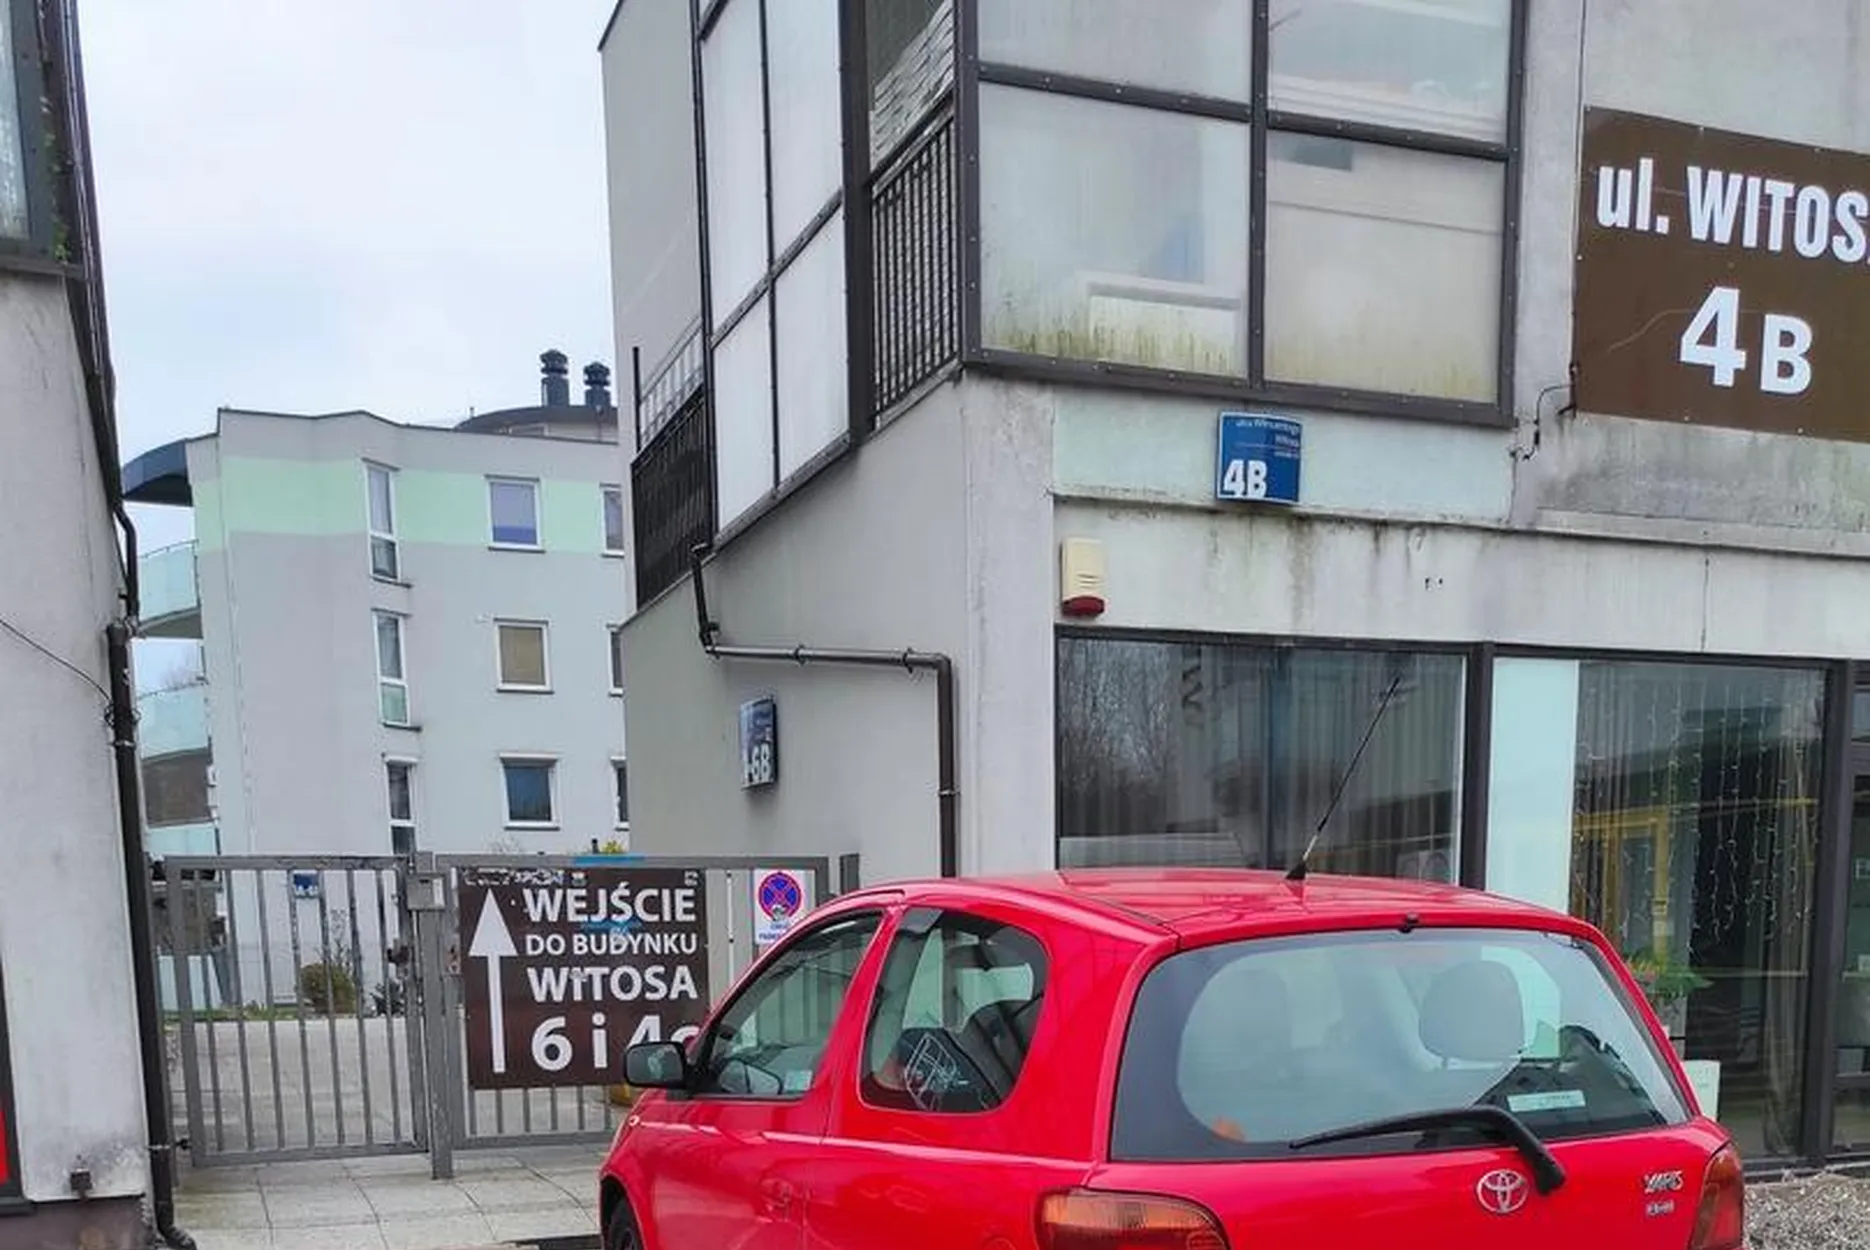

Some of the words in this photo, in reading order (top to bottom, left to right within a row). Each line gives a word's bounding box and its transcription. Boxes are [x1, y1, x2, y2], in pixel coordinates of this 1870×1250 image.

[1597, 157, 1669, 235] ul.
[1686, 165, 1870, 264] WITOS
[1223, 459, 1267, 498] 4B
[523, 881, 696, 922] WEJŚCIE
[526, 934, 566, 955] DO
[573, 933, 697, 955] BUDYNKU
[527, 965, 698, 1002] WITOSA
[531, 1016, 573, 1071] 6
[592, 1012, 608, 1068] i
